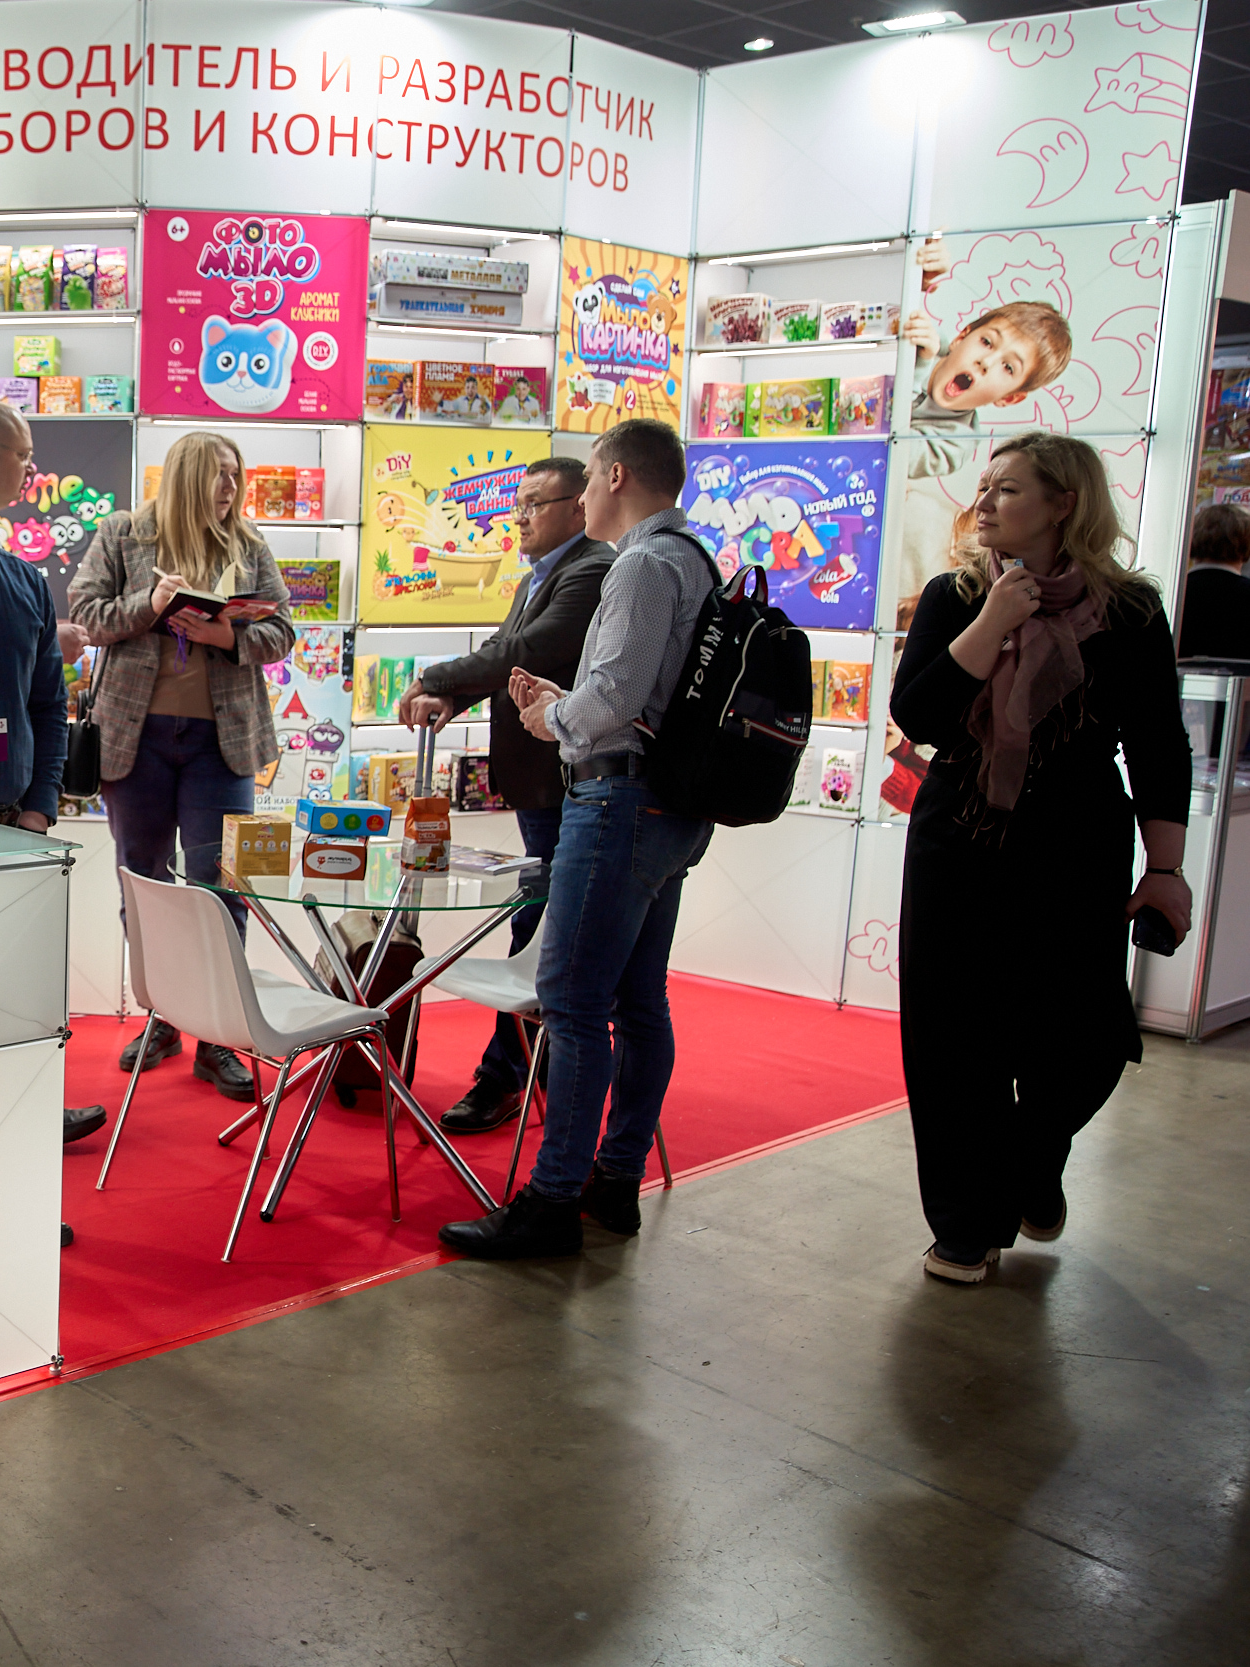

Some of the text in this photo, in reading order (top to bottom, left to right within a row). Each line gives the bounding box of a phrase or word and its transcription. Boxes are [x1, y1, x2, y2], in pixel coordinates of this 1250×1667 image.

[321, 50, 351, 94] И
[377, 54, 655, 141] РАЗРАБОТЧИК
[193, 110, 226, 152] И
[251, 112, 630, 193] КОНСТРУКТОРОВ
[170, 224, 186, 234] 6+
[214, 217, 302, 248] ФОТО
[198, 243, 318, 279] МЫЛО
[230, 277, 283, 316] 3D
[299, 291, 340, 307] АРОМАТ
[291, 307, 340, 322] КЛУБНИКИ
[581, 321, 668, 362] КАРТИНКА
[425, 362, 463, 374] ЦВЕТНОЕ
[425, 371, 455, 381] ПЛАМЯ
[625, 389, 635, 409] 2
[385, 453, 412, 472] DiY
[441, 469, 528, 503] ЖЕМЧУЖИН
[697, 464, 731, 492] DIY
[849, 473, 865, 489] 3+
[478, 486, 500, 501] ДЛЯ
[848, 489, 877, 506] ГОД
[467, 494, 516, 515] ВАННЫ
[686, 492, 802, 537] МЫЛО
[739, 513, 864, 572] CRAFT
[820, 589, 840, 604] Cola
[686, 616, 726, 701] TOMM
[255, 795, 297, 805] ОЙ НАБО
